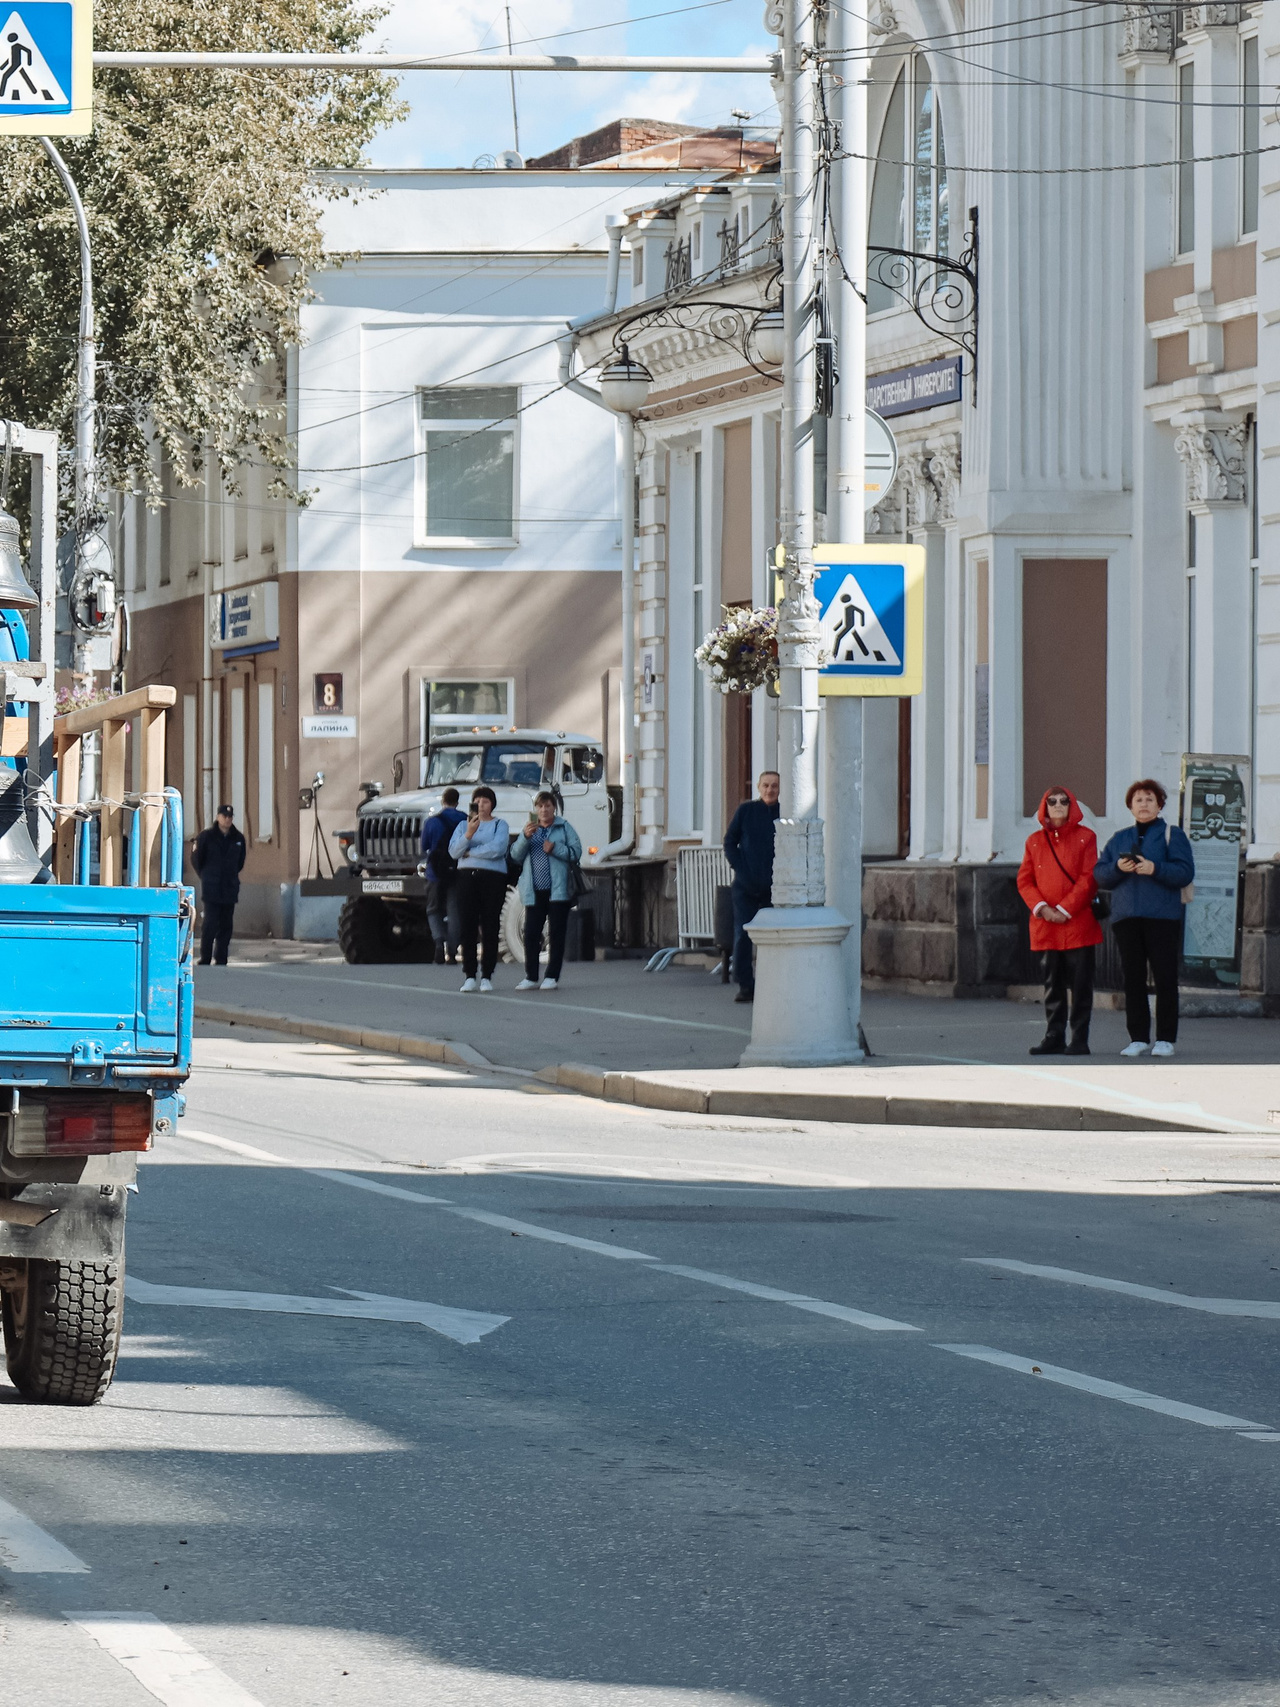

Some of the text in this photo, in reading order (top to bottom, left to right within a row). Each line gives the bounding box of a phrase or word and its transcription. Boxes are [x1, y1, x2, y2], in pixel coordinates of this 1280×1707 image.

[913, 367, 955, 399] УНИВЕРСИТЕТ
[323, 683, 336, 706] 8
[1207, 818, 1222, 828] 27
